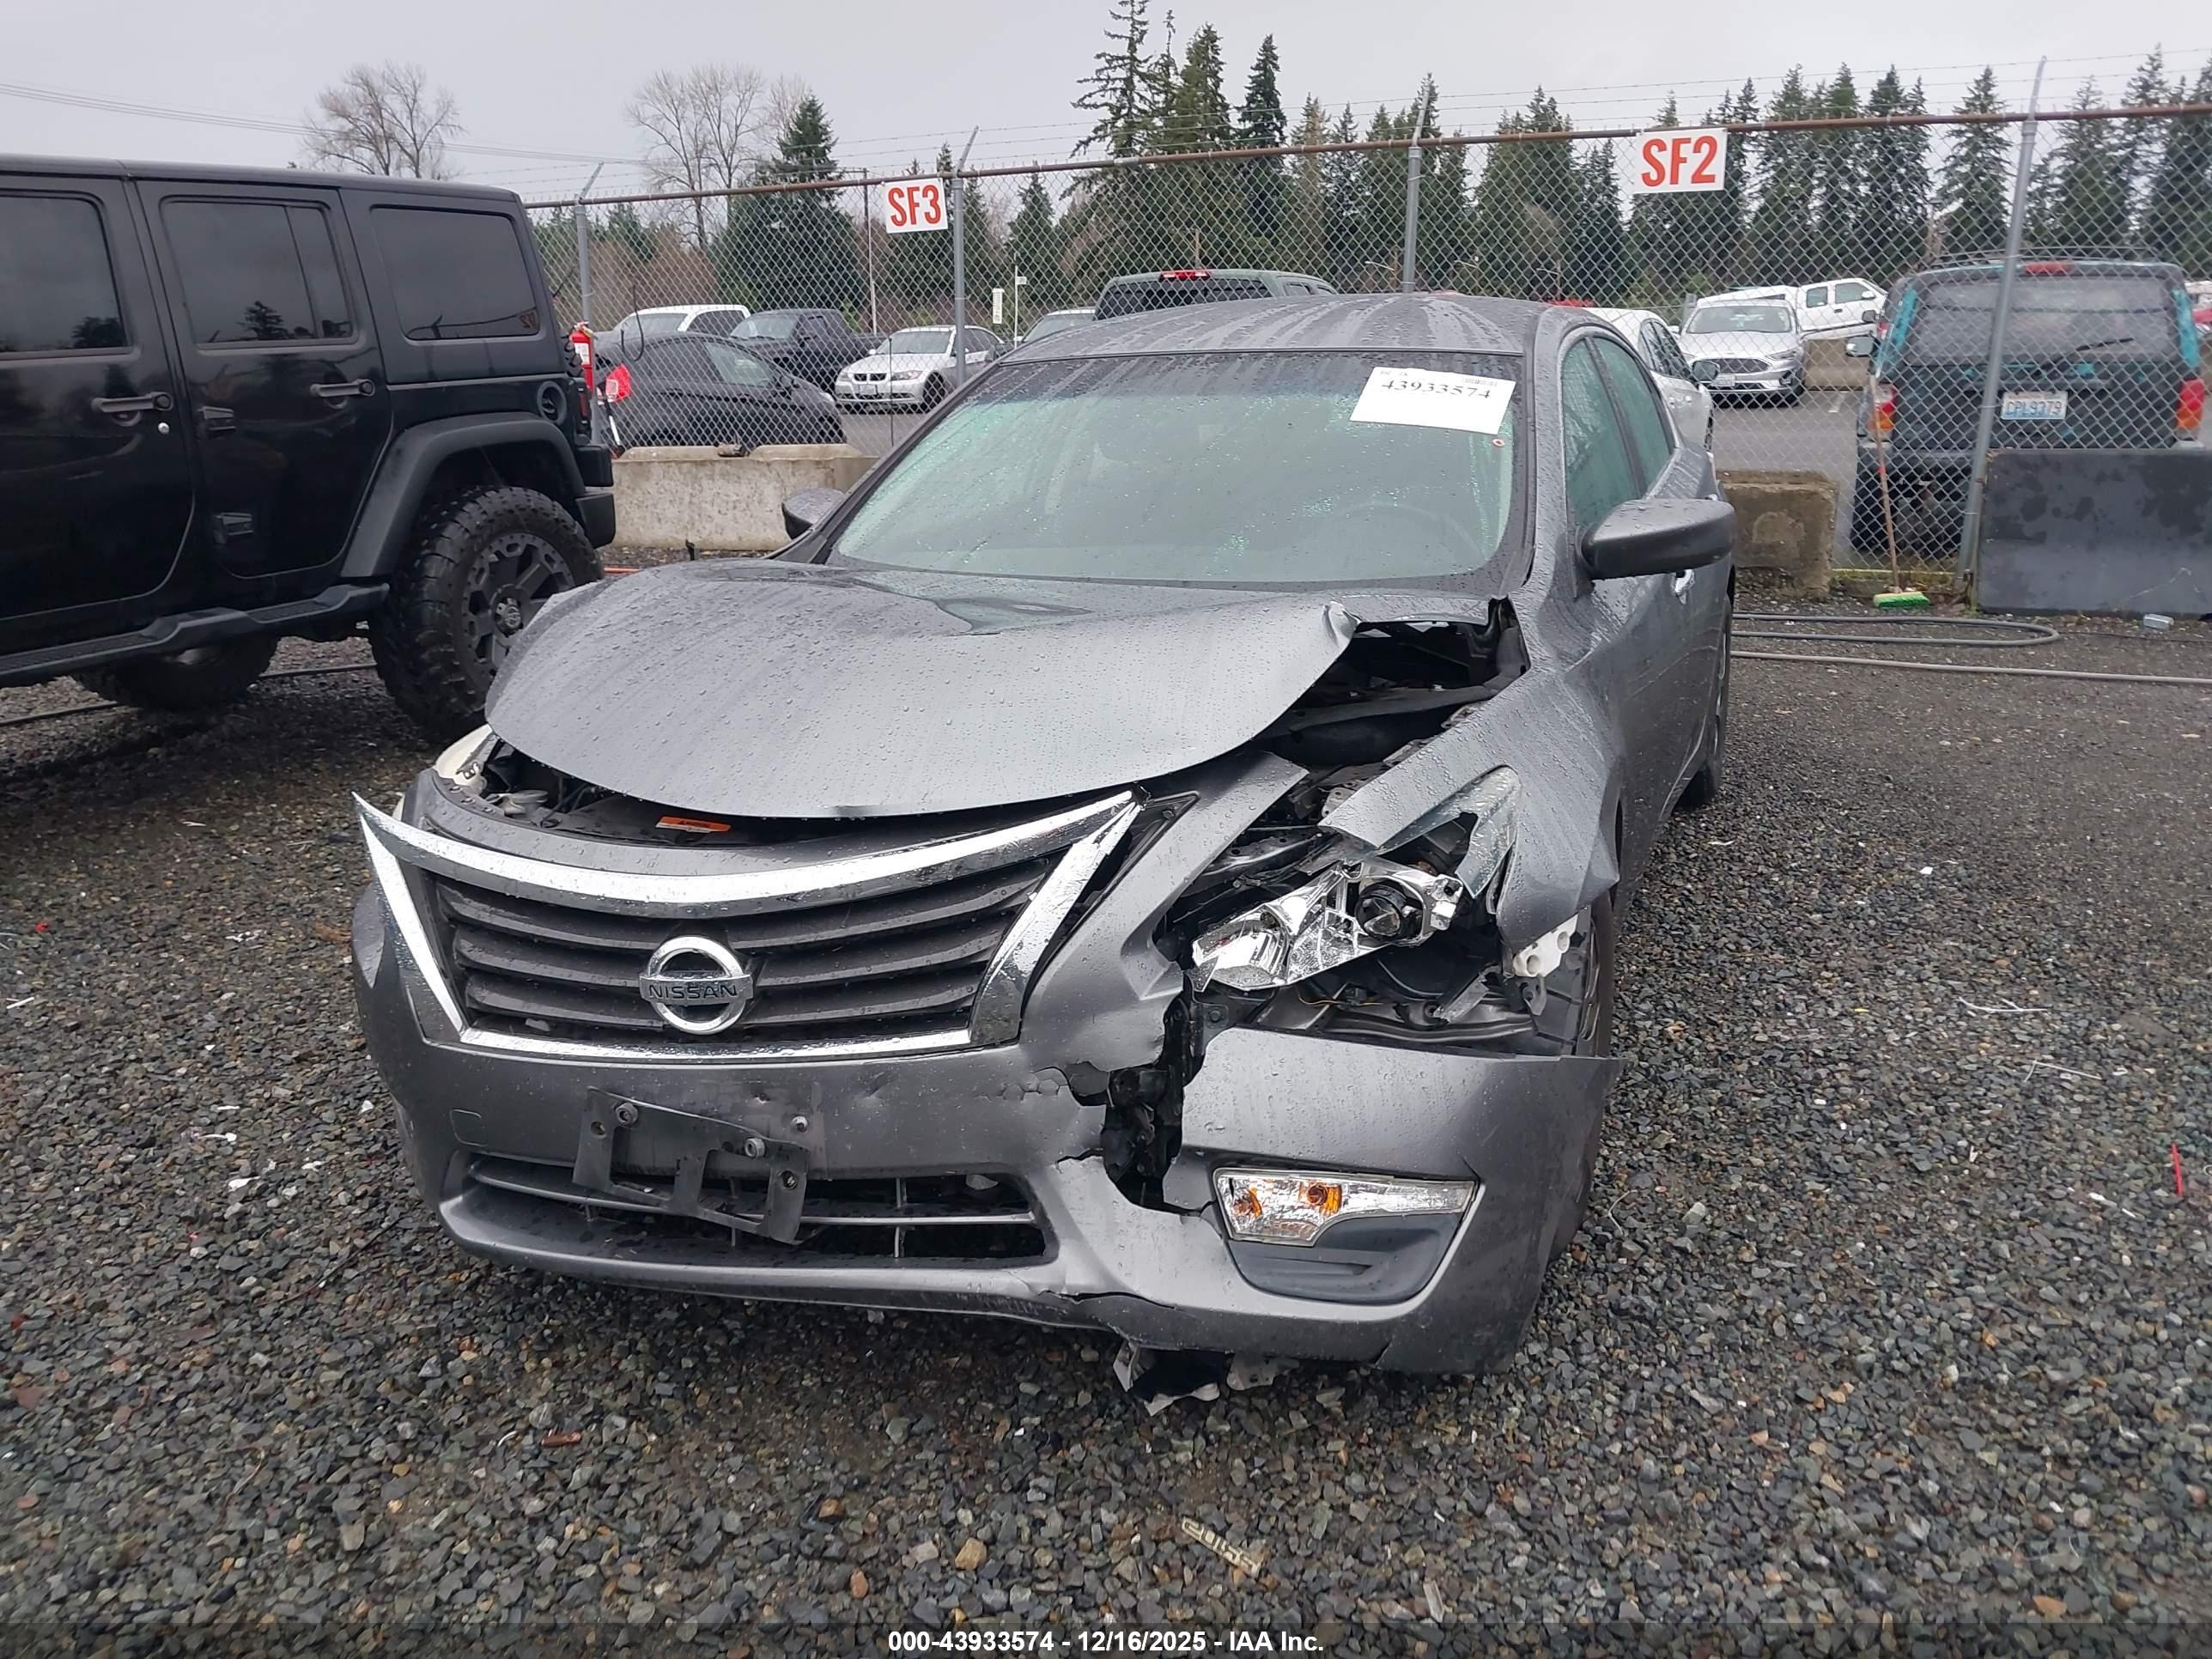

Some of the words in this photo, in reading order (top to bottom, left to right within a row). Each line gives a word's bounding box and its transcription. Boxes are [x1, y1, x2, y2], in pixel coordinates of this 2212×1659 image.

[1641, 136, 1718, 187] SF2
[888, 184, 942, 227] SF3
[1382, 380, 1491, 399] 43933574
[648, 983, 738, 1000] NISSAN
